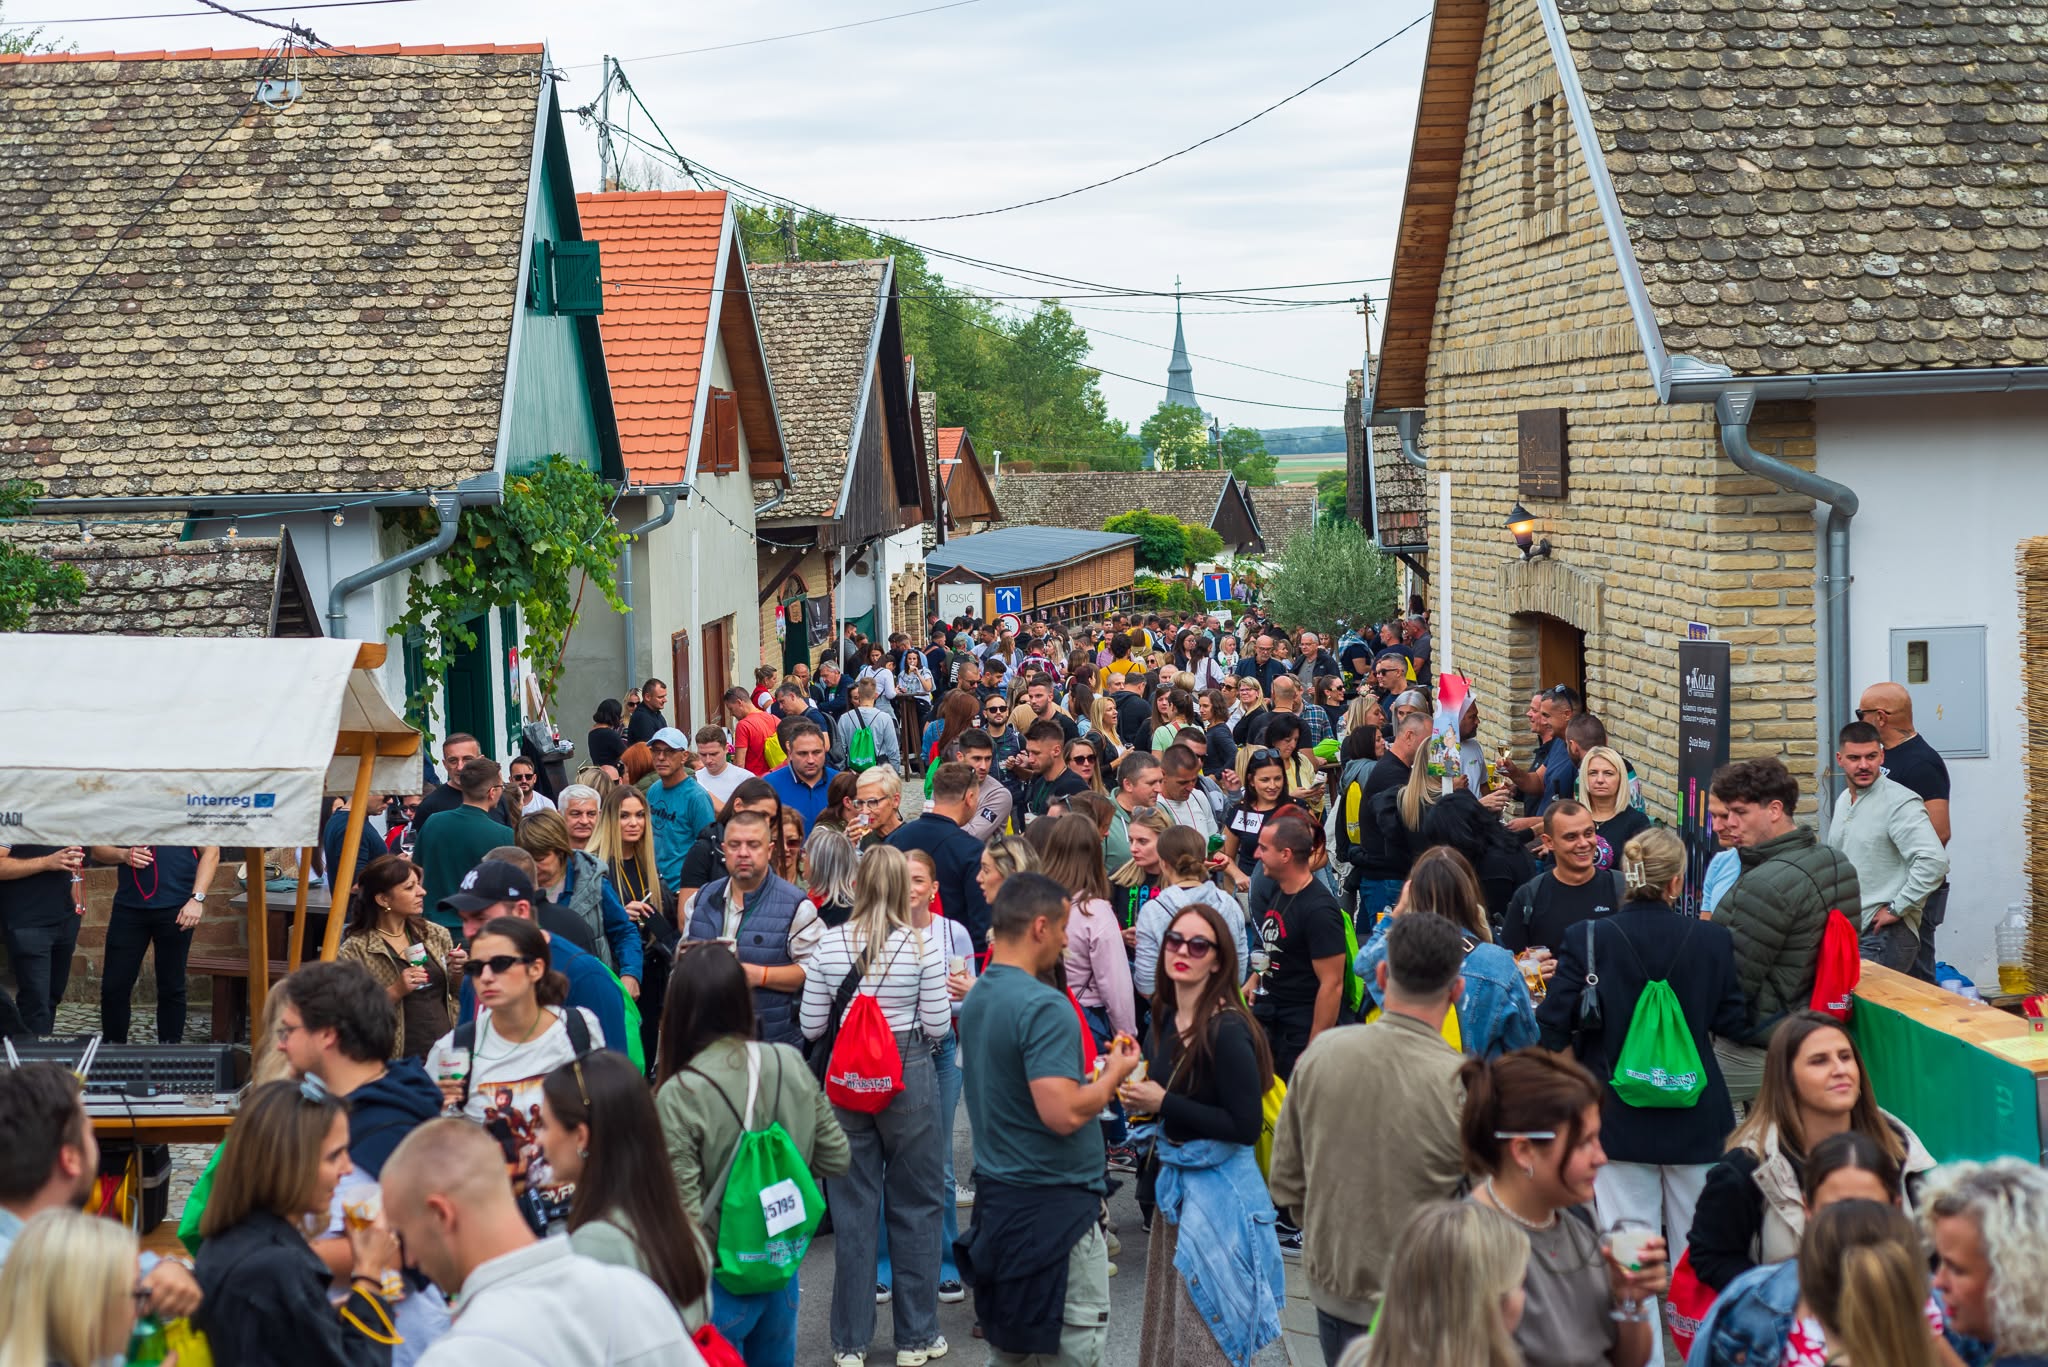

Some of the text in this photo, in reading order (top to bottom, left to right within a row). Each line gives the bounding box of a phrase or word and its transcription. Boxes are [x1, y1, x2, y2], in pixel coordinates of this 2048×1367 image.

[1691, 667, 1715, 691] KOLAR
[187, 794, 250, 808] Interreg
[846, 1077, 892, 1089] MARATON
